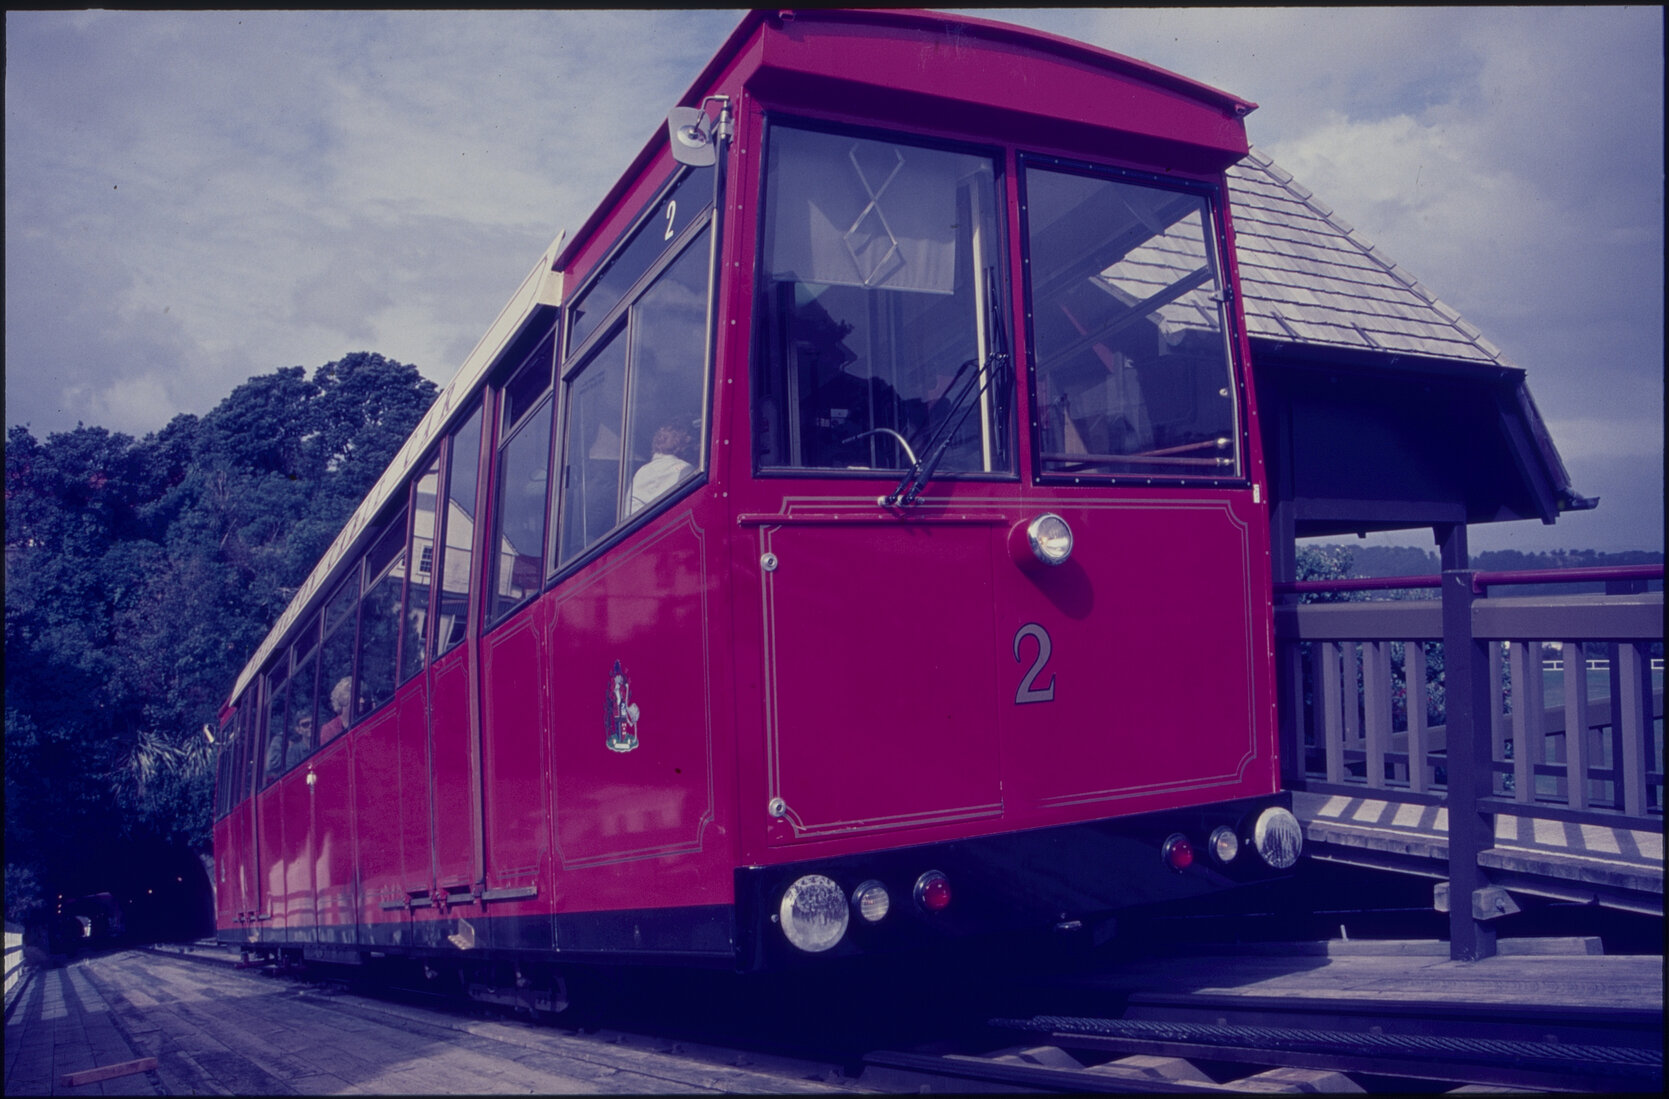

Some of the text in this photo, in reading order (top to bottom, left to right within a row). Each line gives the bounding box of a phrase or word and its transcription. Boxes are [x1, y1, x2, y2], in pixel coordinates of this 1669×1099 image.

[665, 200, 676, 241] 2
[404, 382, 456, 467] CAR
[1012, 622, 1056, 705] 2
